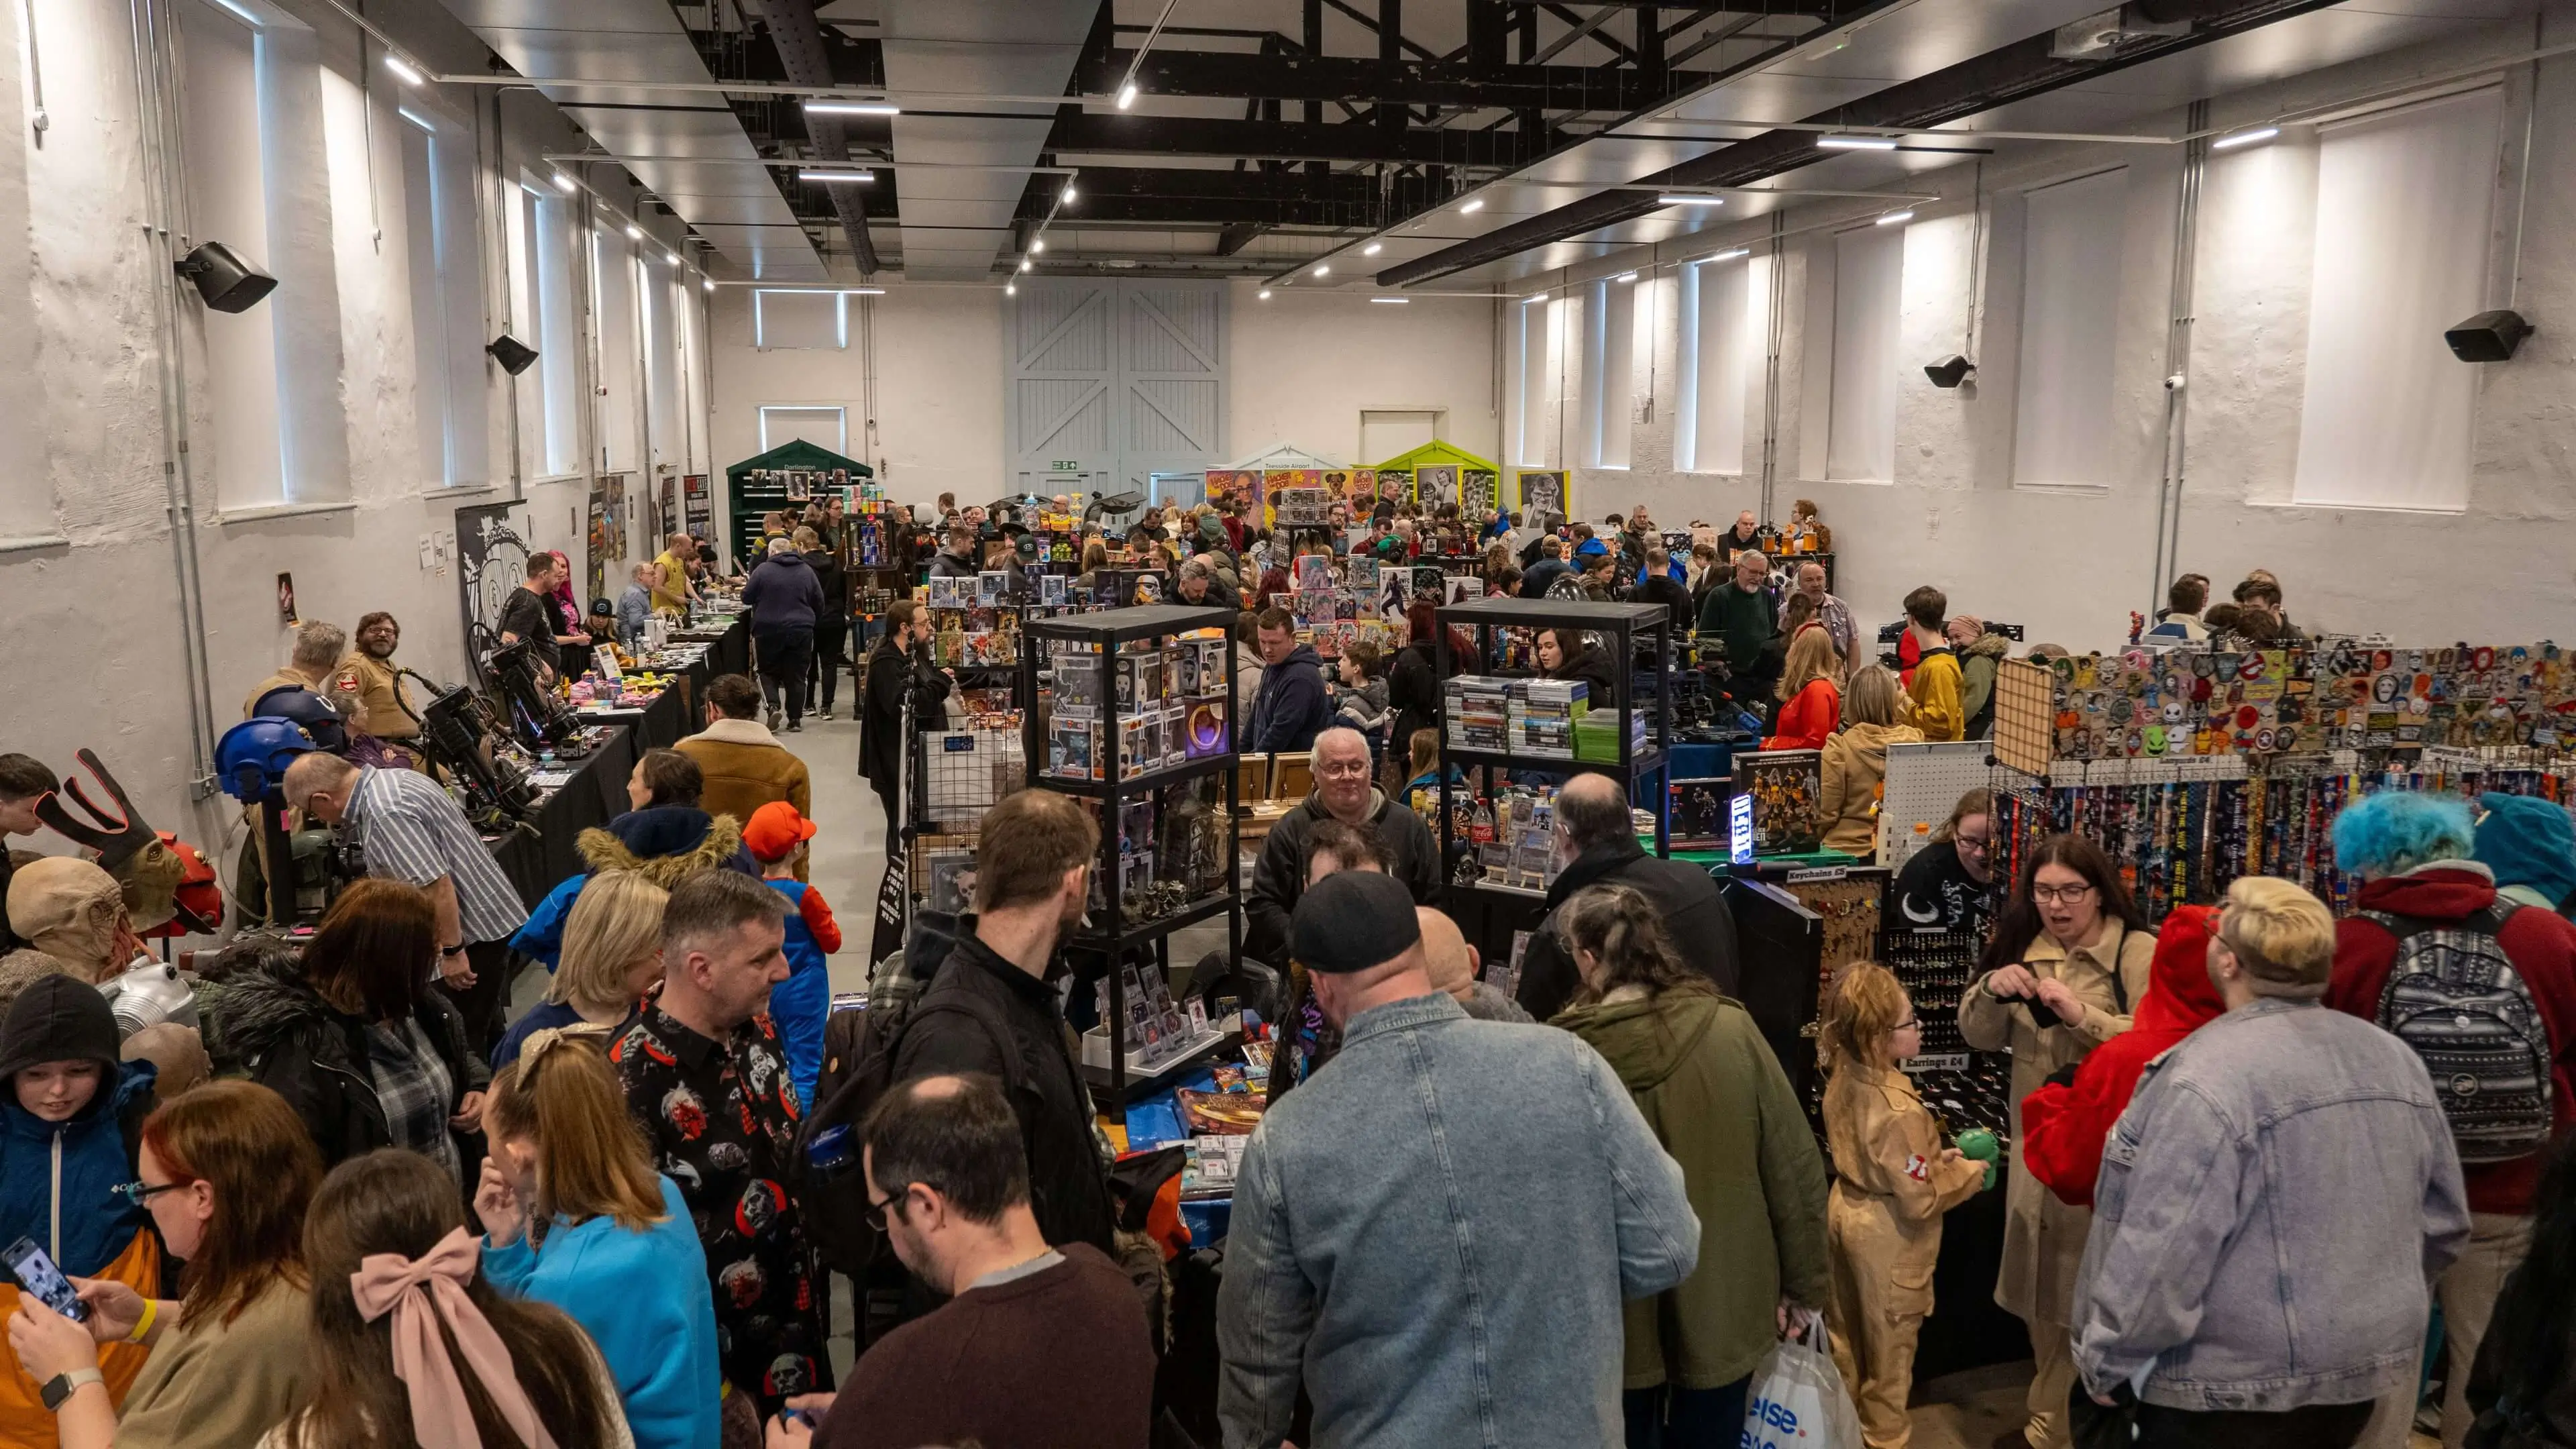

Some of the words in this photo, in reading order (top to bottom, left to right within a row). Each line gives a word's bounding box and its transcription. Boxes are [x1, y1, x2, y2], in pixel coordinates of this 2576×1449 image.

[2176, 831, 2187, 851] WAY
[1788, 870, 1832, 881] Keychains
[1835, 868, 1845, 876] £5
[1905, 1057, 1947, 1069] Earrings
[1950, 1057, 1964, 1067] £4
